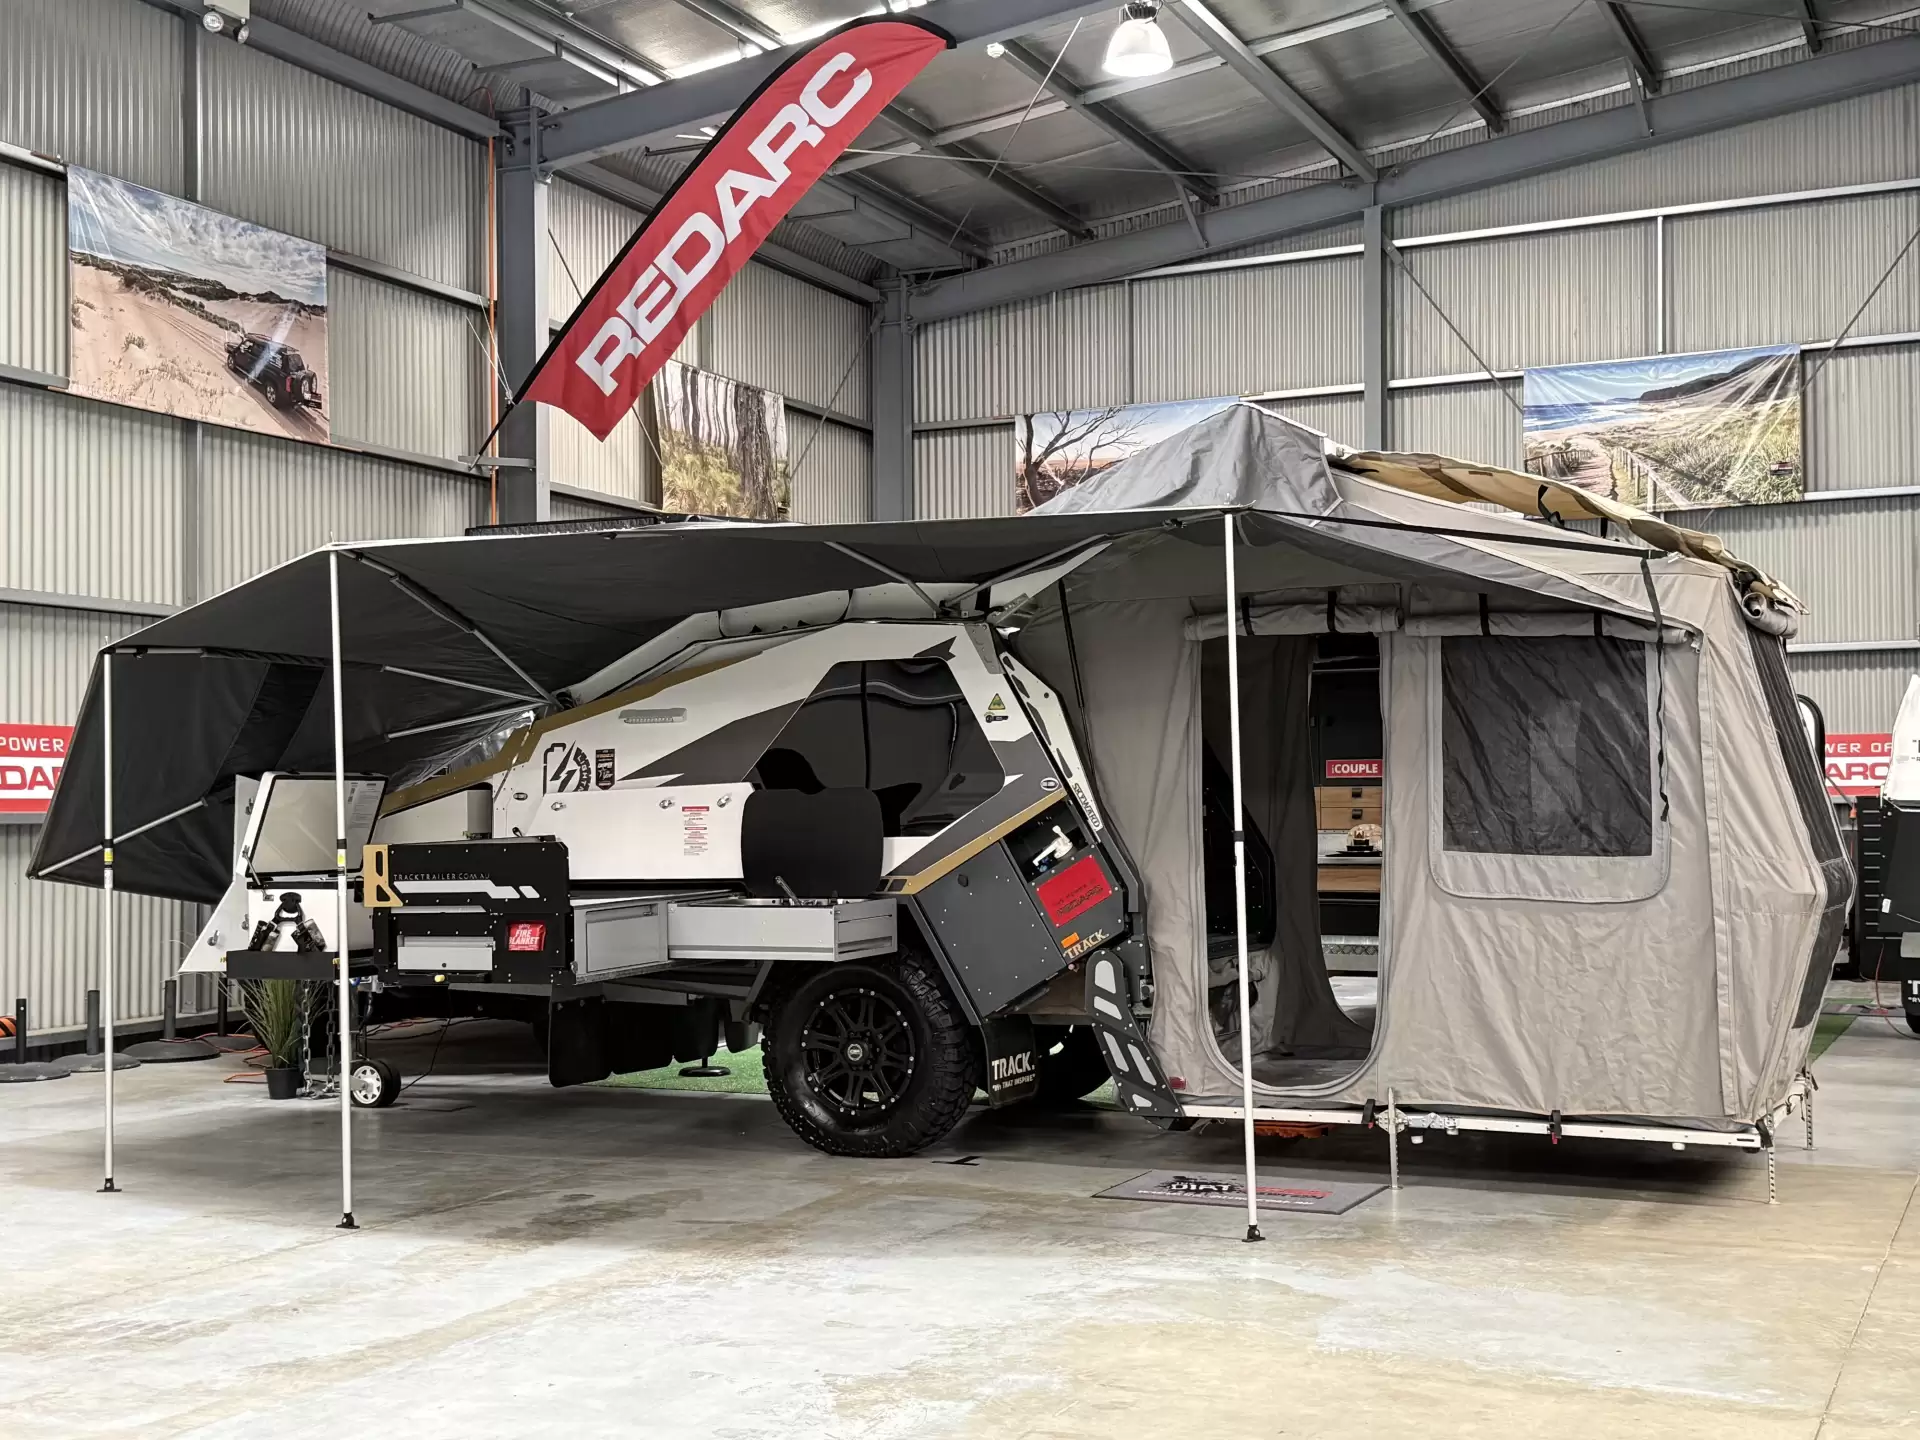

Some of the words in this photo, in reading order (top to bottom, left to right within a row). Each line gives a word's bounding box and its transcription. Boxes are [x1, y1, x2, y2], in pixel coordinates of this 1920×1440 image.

[575, 51, 873, 397] REDARC
[0, 736, 65, 752] POWER
[0, 765, 63, 790] DA
[1072, 782, 1100, 828] SKYWARD
[515, 929, 533, 938] FIRE
